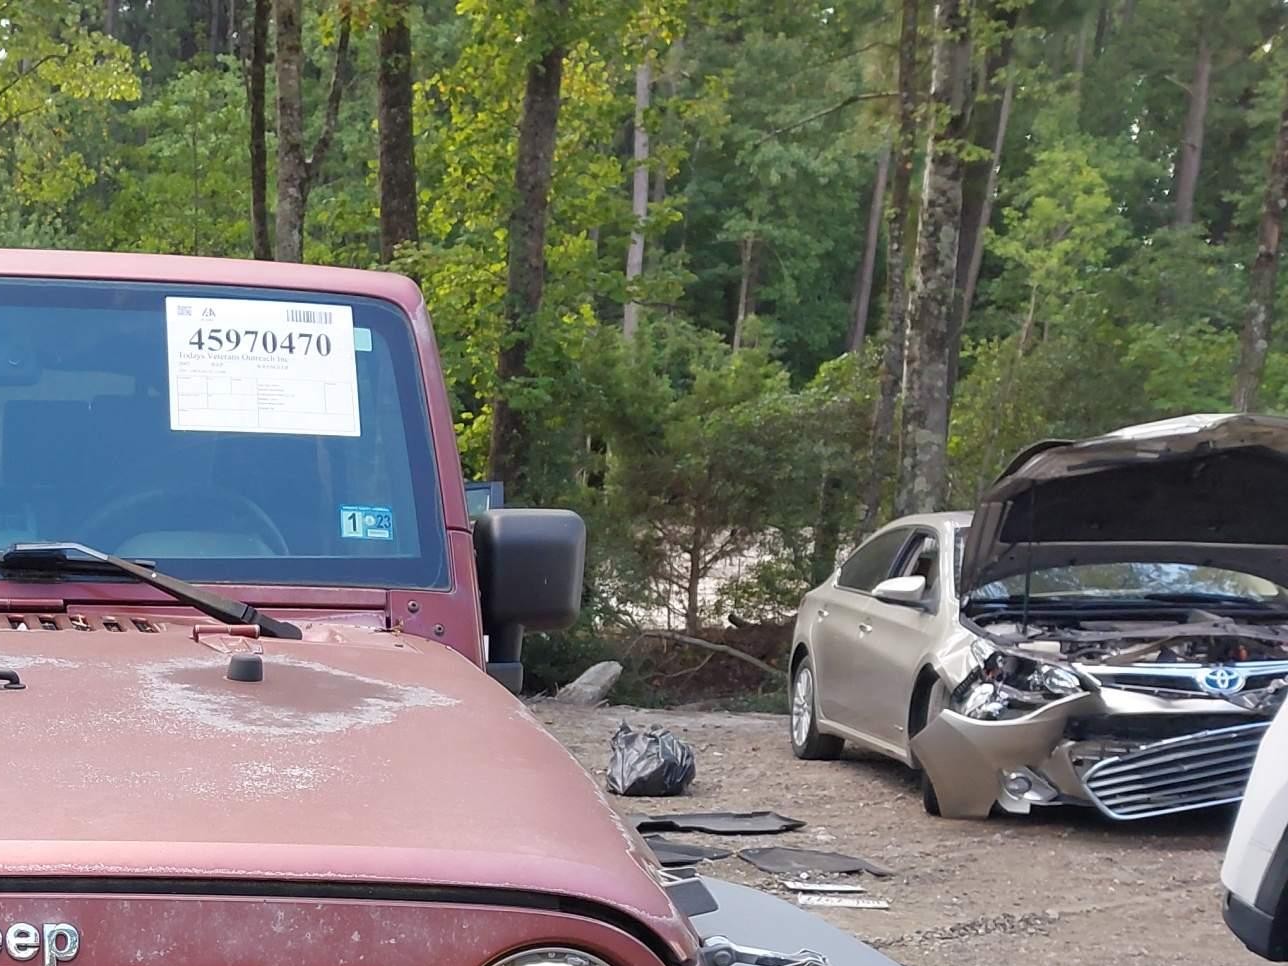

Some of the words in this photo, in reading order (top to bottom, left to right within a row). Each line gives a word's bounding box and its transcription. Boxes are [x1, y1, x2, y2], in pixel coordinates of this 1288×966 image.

[189, 327, 332, 357] 45970470
[207, 352, 240, 361] Veterans
[348, 512, 357, 531] 1
[376, 514, 392, 529] 23
